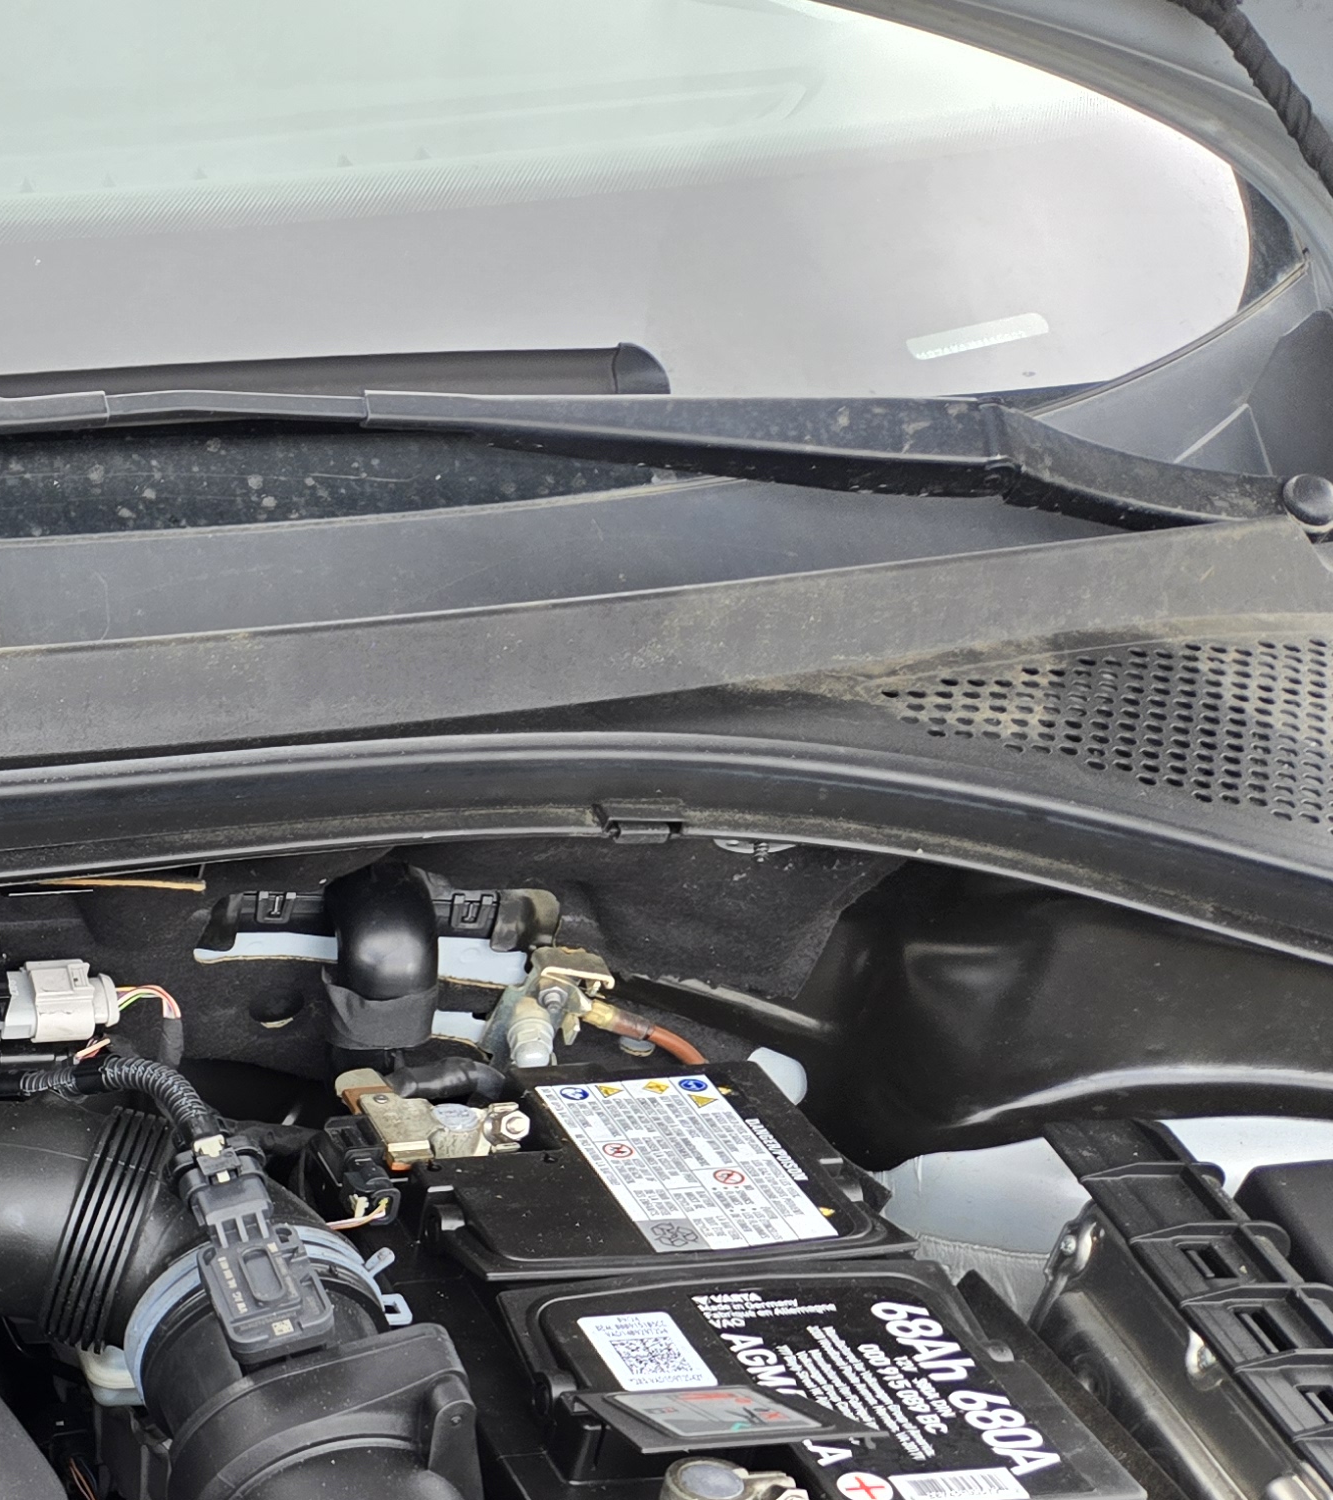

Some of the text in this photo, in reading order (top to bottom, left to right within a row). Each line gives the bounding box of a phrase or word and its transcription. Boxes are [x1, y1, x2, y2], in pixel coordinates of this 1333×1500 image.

[718, 1334, 797, 1385] AGM
[856, 1343, 951, 1435] 000 915 089 BC
[870, 1300, 977, 1383] 68Ah
[947, 1388, 1061, 1477] 680A
